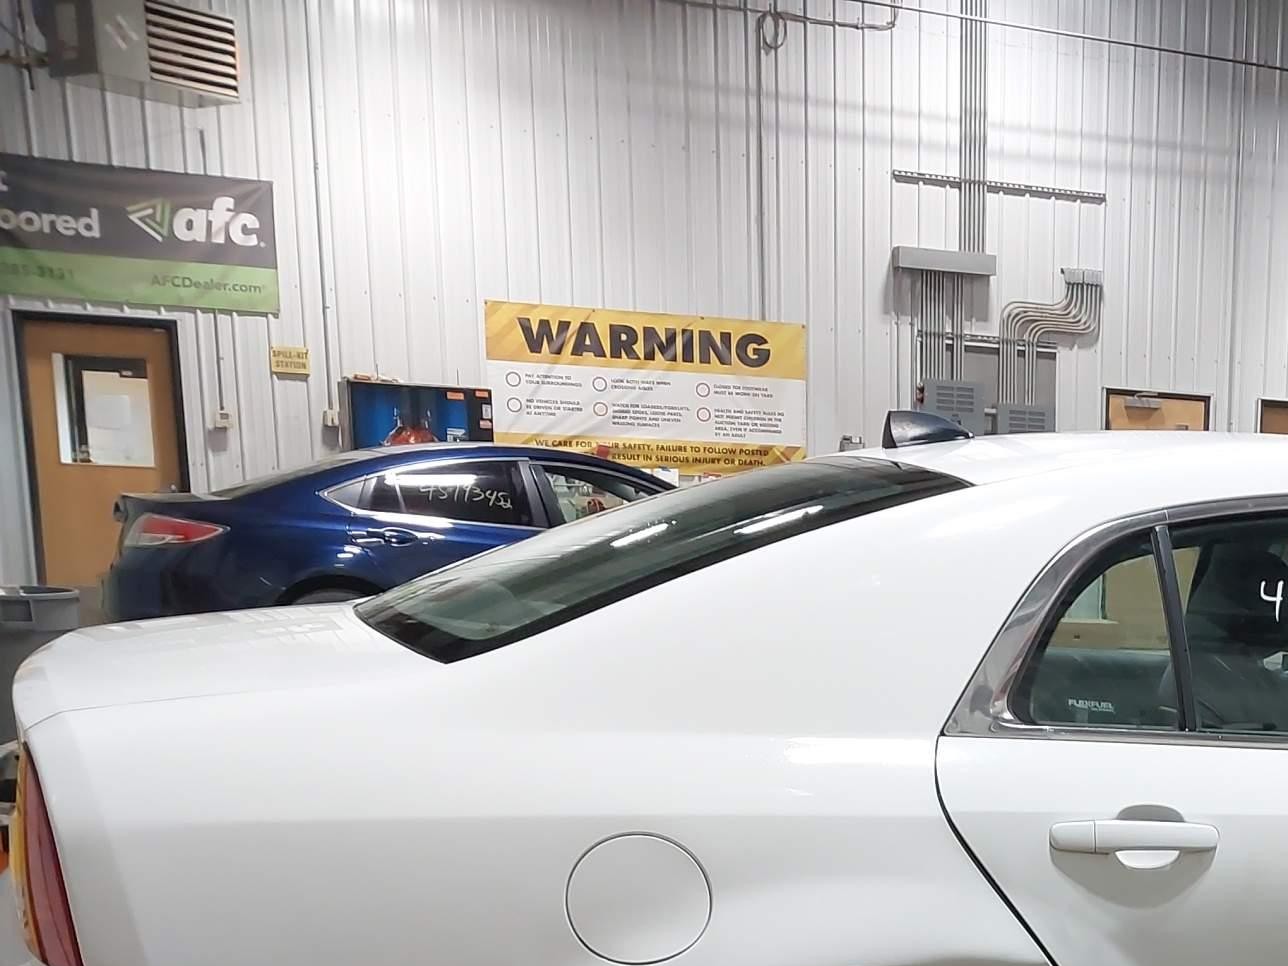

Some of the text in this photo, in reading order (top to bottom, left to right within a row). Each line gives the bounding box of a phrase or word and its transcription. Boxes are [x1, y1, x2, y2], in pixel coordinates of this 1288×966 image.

[172, 197, 260, 247] afc
[151, 274, 262, 294] AFCDealer.com
[517, 317, 772, 369] WARNING
[275, 360, 307, 369] STATION
[535, 439, 550, 447] WE
[656, 444, 687, 452] FAILURE
[704, 446, 736, 455] FOLLOW
[740, 448, 769, 456] POSTED
[655, 455, 689, 463] SERIOUS
[692, 456, 720, 464] INJURY
[724, 457, 735, 465] OR
